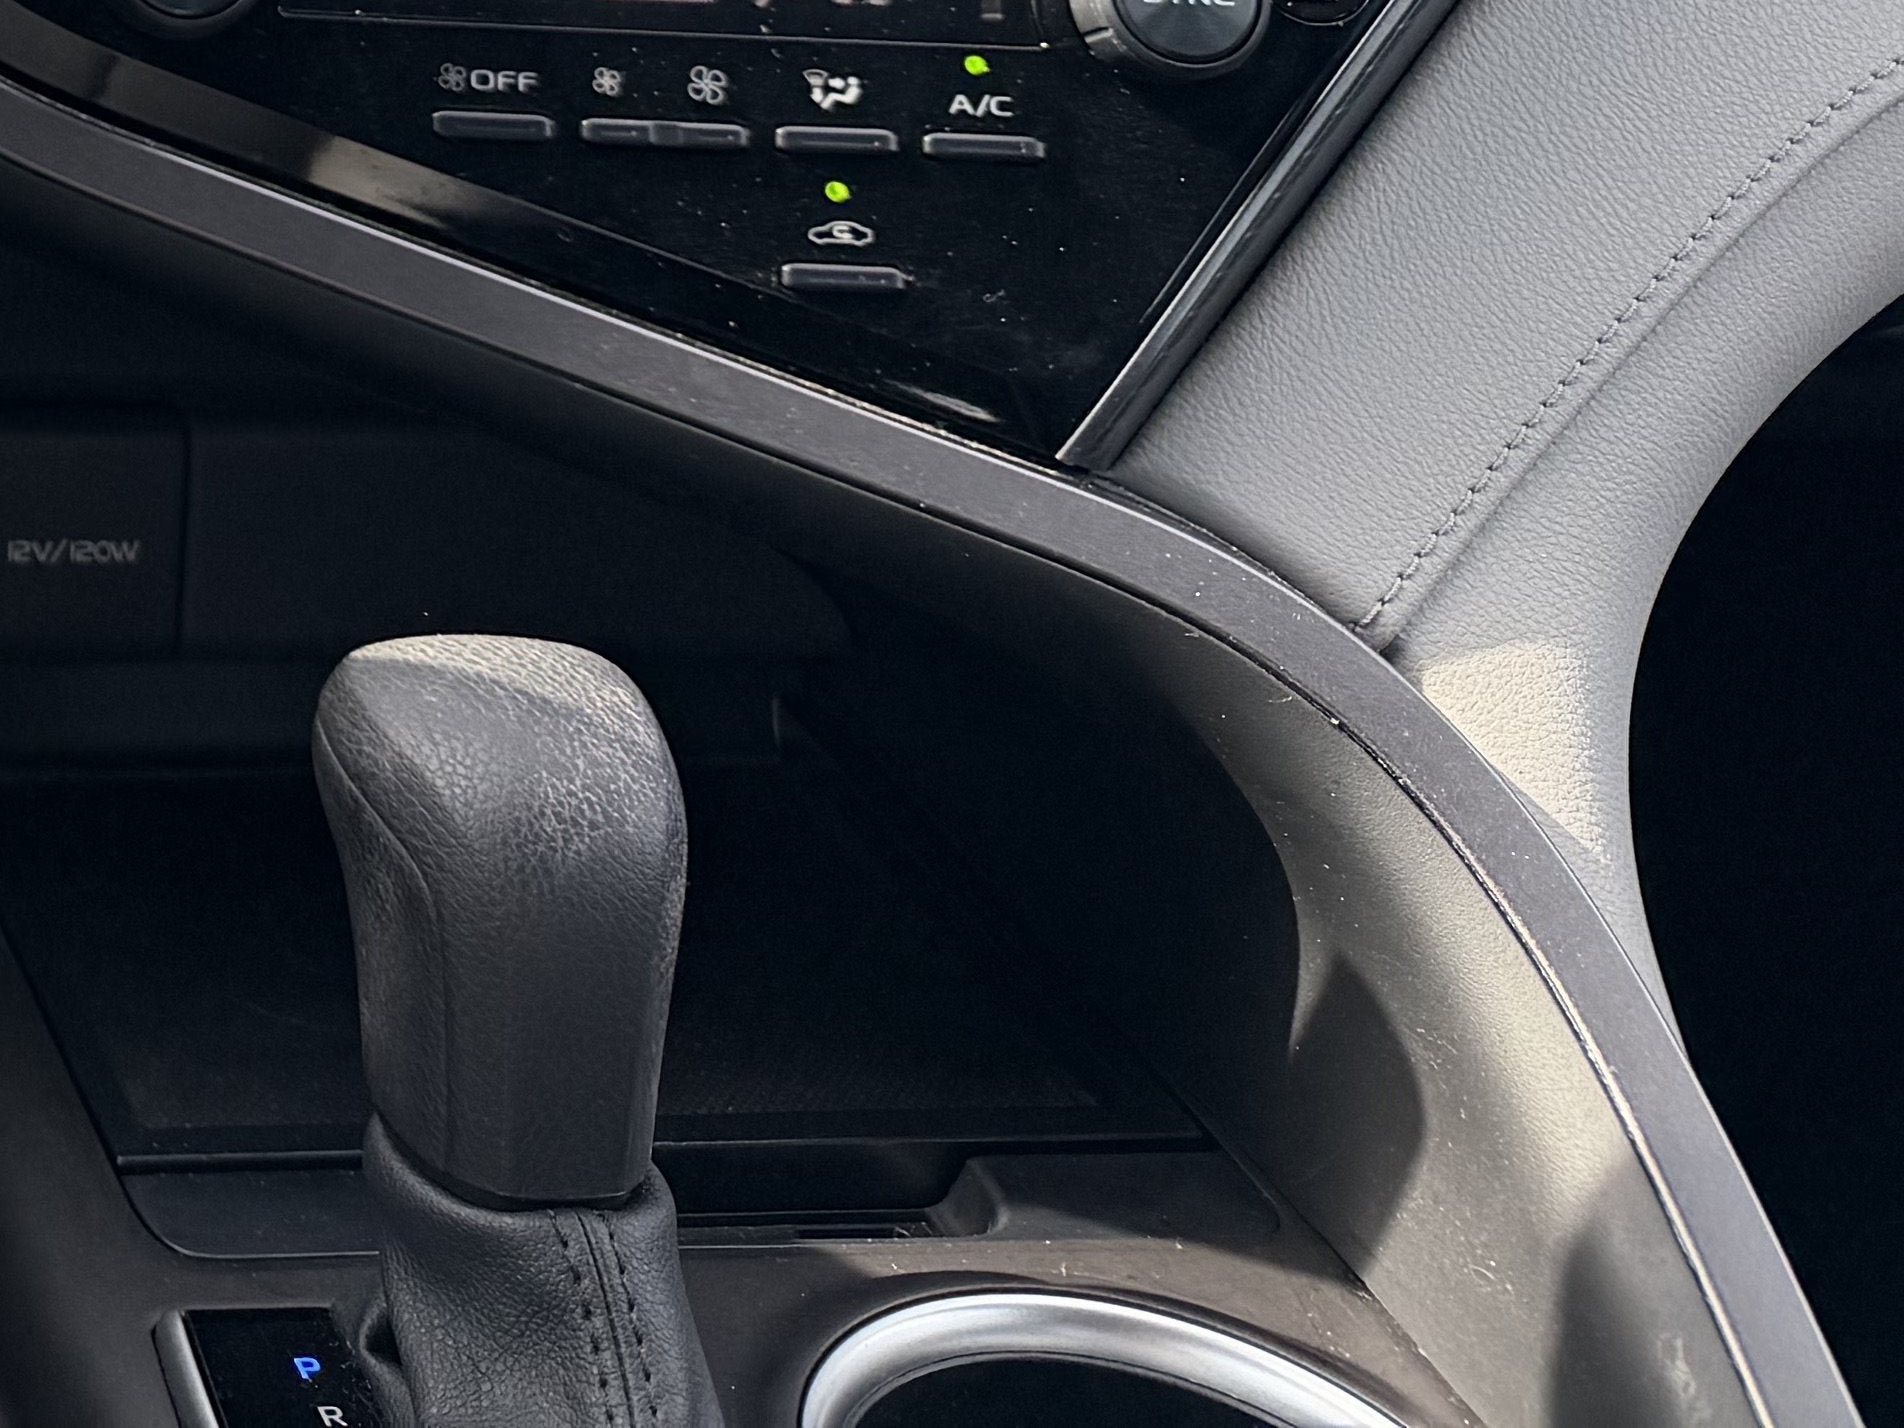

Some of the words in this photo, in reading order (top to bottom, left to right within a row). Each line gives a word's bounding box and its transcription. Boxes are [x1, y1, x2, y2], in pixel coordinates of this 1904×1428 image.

[469, 69, 540, 92] OFF
[948, 93, 1015, 119] A/C
[6, 538, 142, 564] 12V/120W
[293, 1356, 322, 1383] P
[316, 1405, 349, 1428] R
